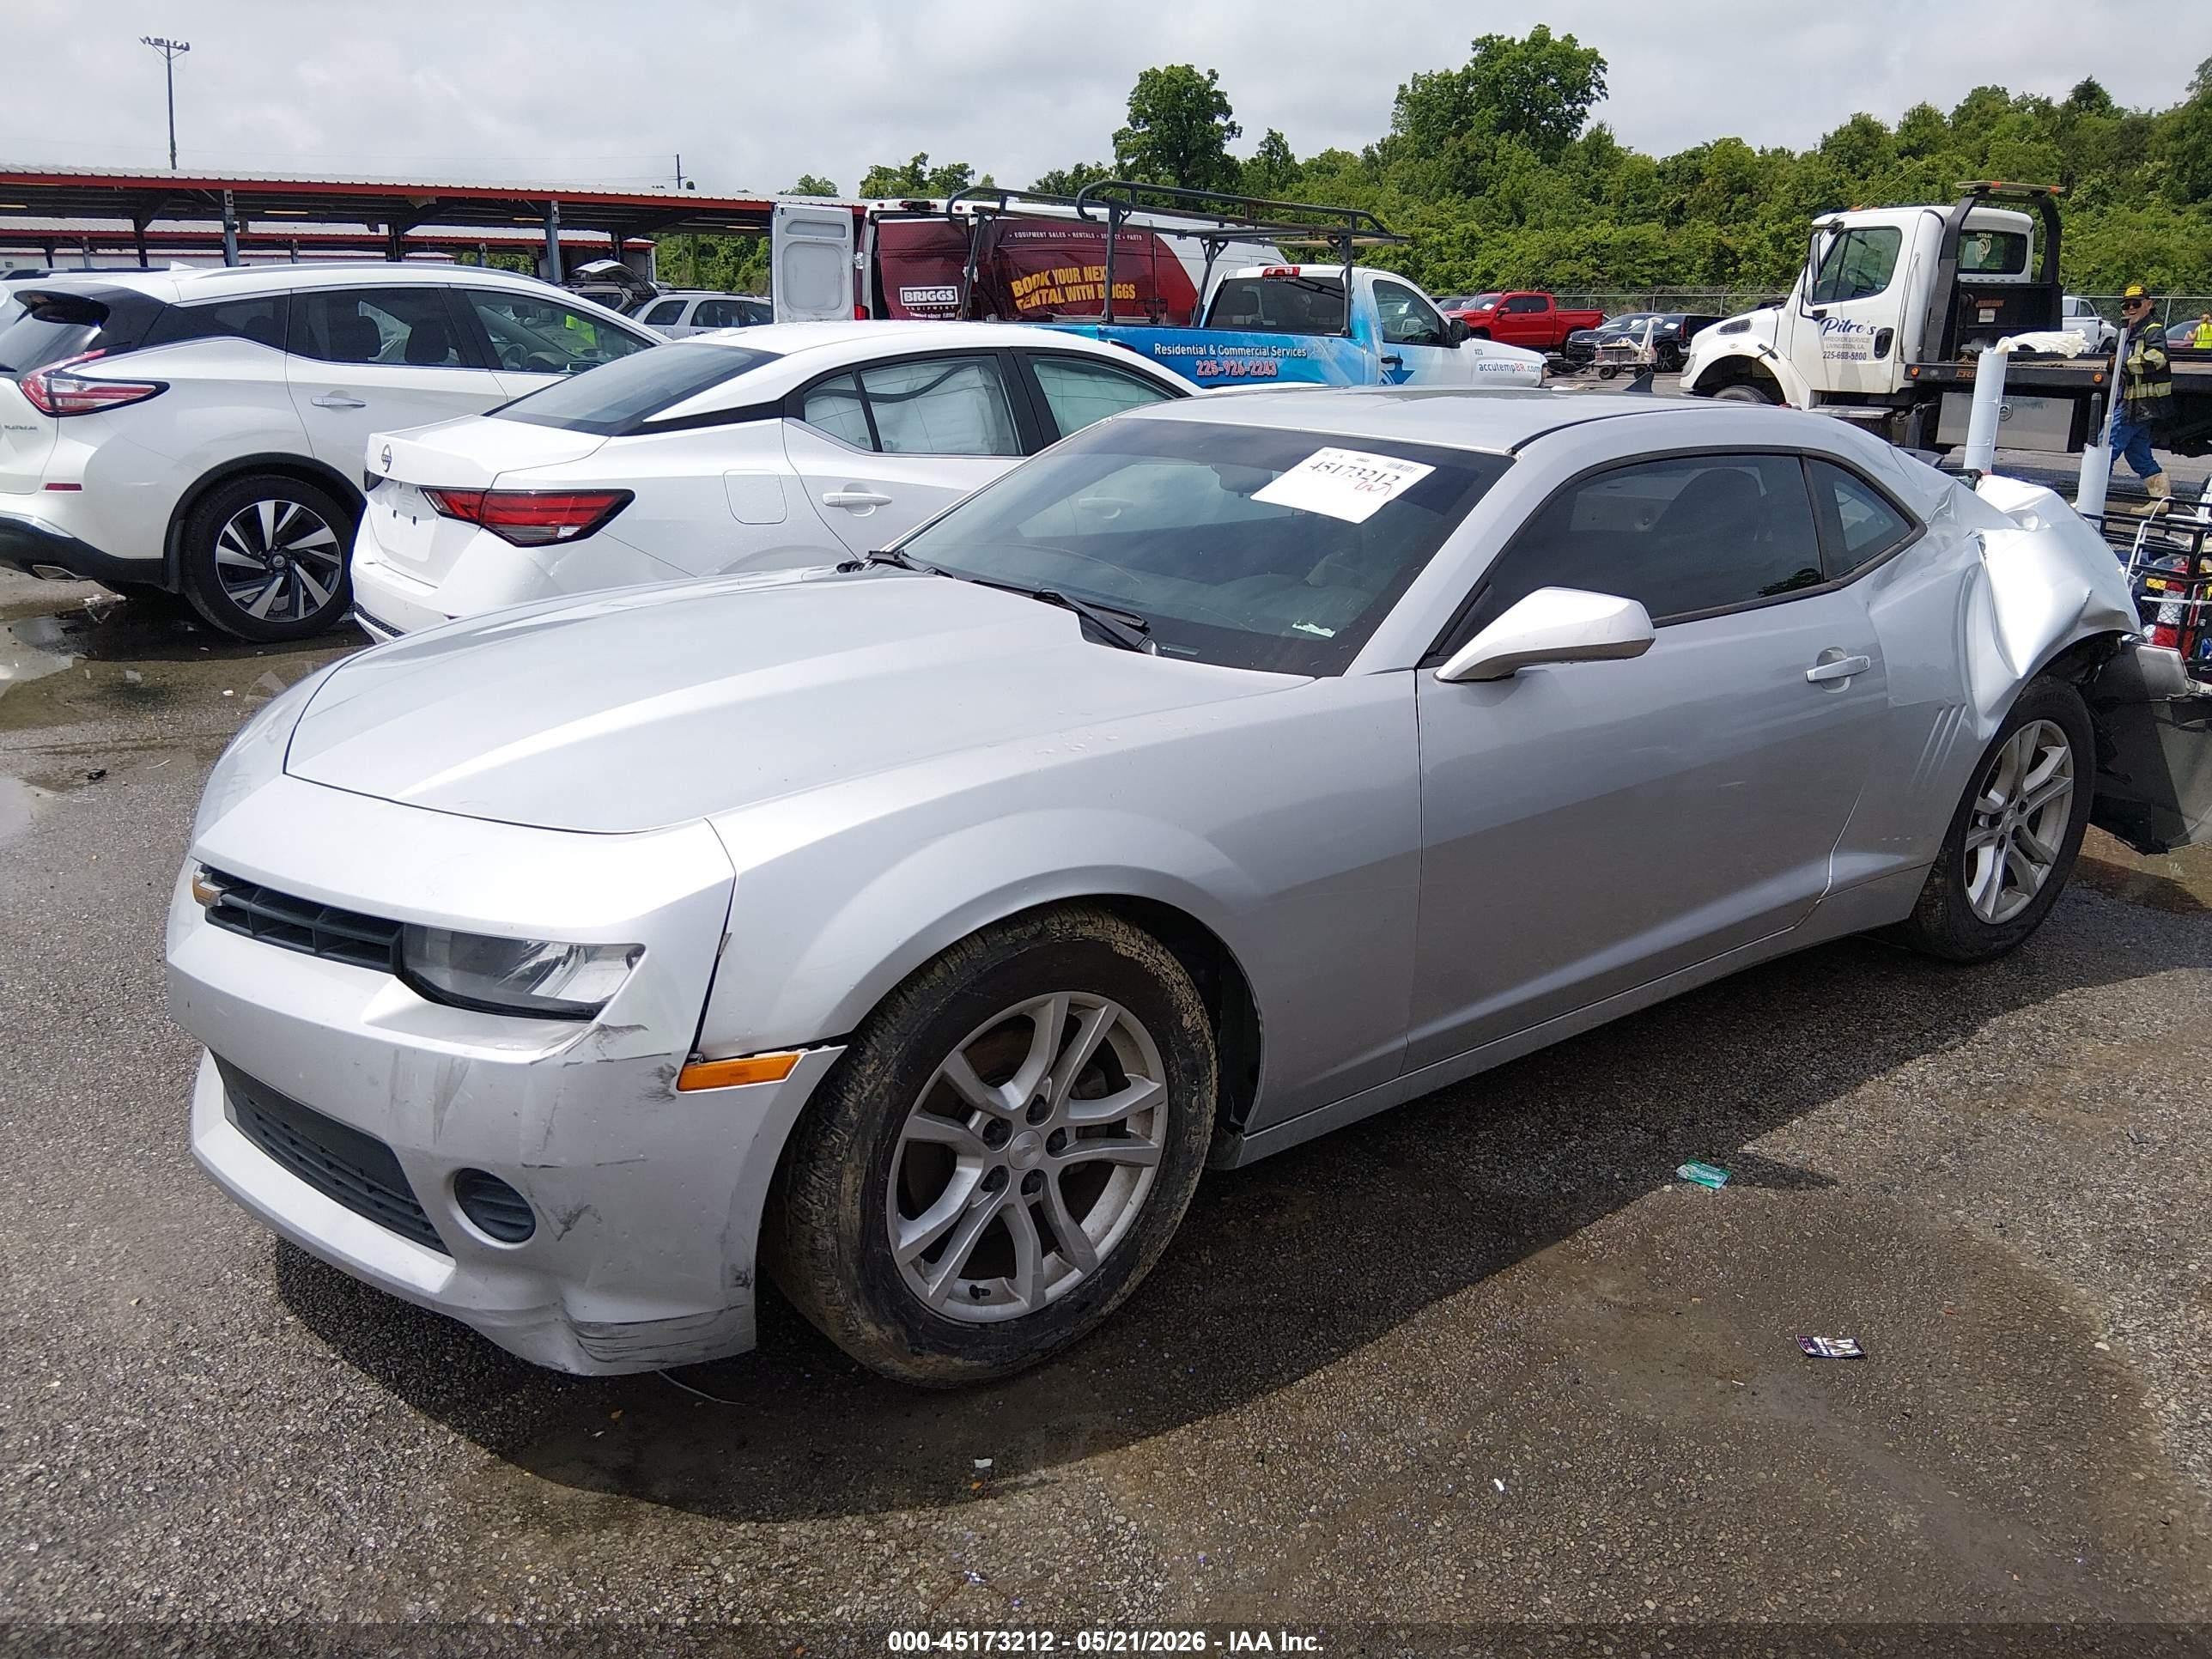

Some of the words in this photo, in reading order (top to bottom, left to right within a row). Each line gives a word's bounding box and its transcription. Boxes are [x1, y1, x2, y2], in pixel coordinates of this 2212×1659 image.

[1011, 269, 1051, 298] BOOK
[1052, 267, 1082, 285] YOUR
[1083, 265, 1108, 283] NEX
[903, 289, 955, 302] BRIGGS
[1065, 283, 1095, 302] WITH
[1097, 283, 1136, 300] BIGGS
[1820, 317, 1877, 336] Pitre's
[1154, 343, 1206, 356] Residential
[1209, 345, 1216, 356] &
[1218, 345, 1270, 357] Commercial
[1271, 345, 1307, 357] Services
[1195, 360, 1278, 376] 225-926-2243
[1309, 460, 1401, 486] 45173212
